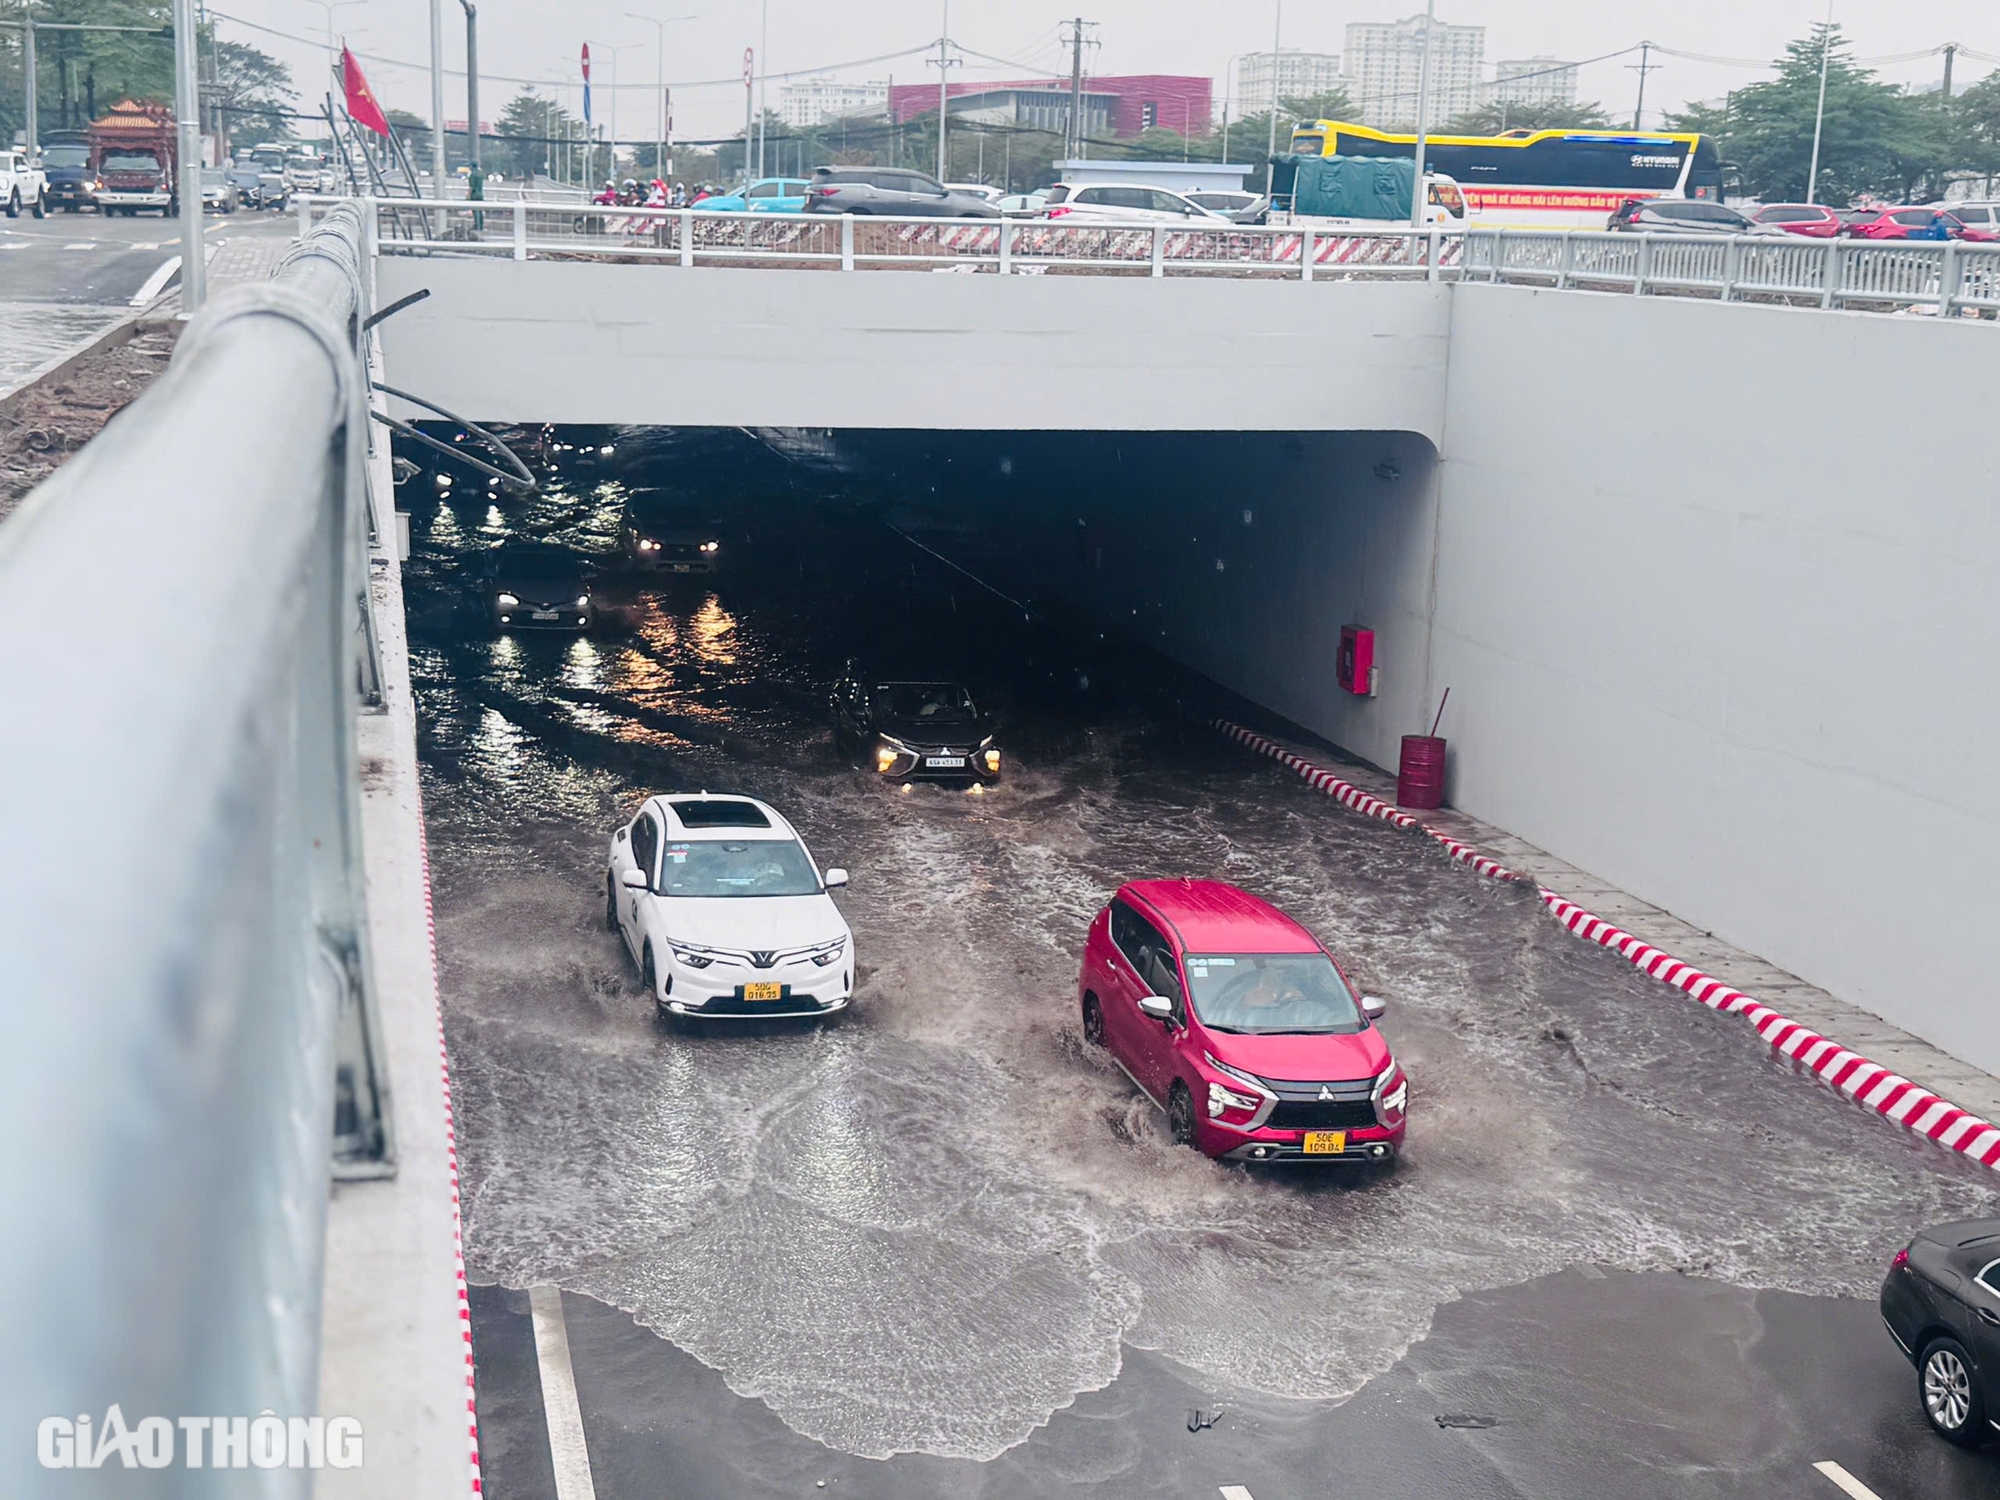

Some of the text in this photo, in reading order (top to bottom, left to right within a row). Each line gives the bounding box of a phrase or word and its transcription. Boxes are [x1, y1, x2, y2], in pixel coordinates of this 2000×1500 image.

[1643, 156, 1680, 164] HYUNDAI
[1316, 1132, 1334, 1142] 50E
[1310, 1142, 1340, 1152] 109.04
